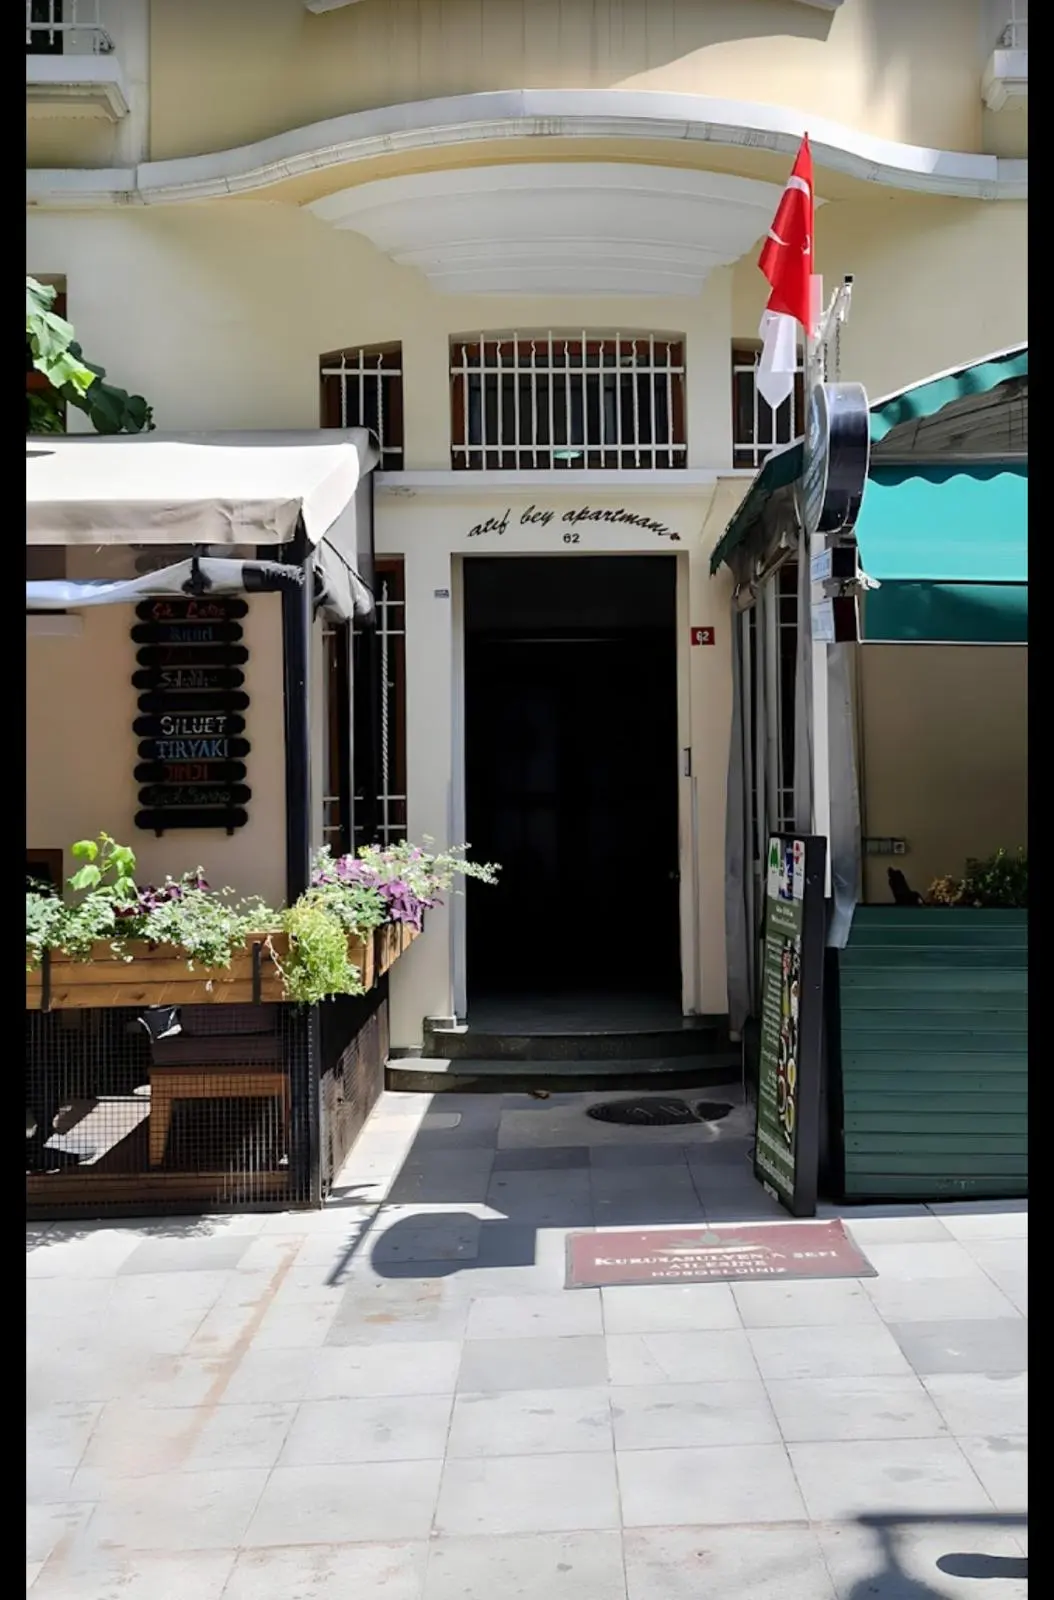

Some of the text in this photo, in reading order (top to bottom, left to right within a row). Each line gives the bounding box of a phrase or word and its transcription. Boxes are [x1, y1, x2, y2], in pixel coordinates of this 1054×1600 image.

[520, 504, 554, 527] bey
[563, 533, 580, 543] 62
[696, 631, 710, 642] 62
